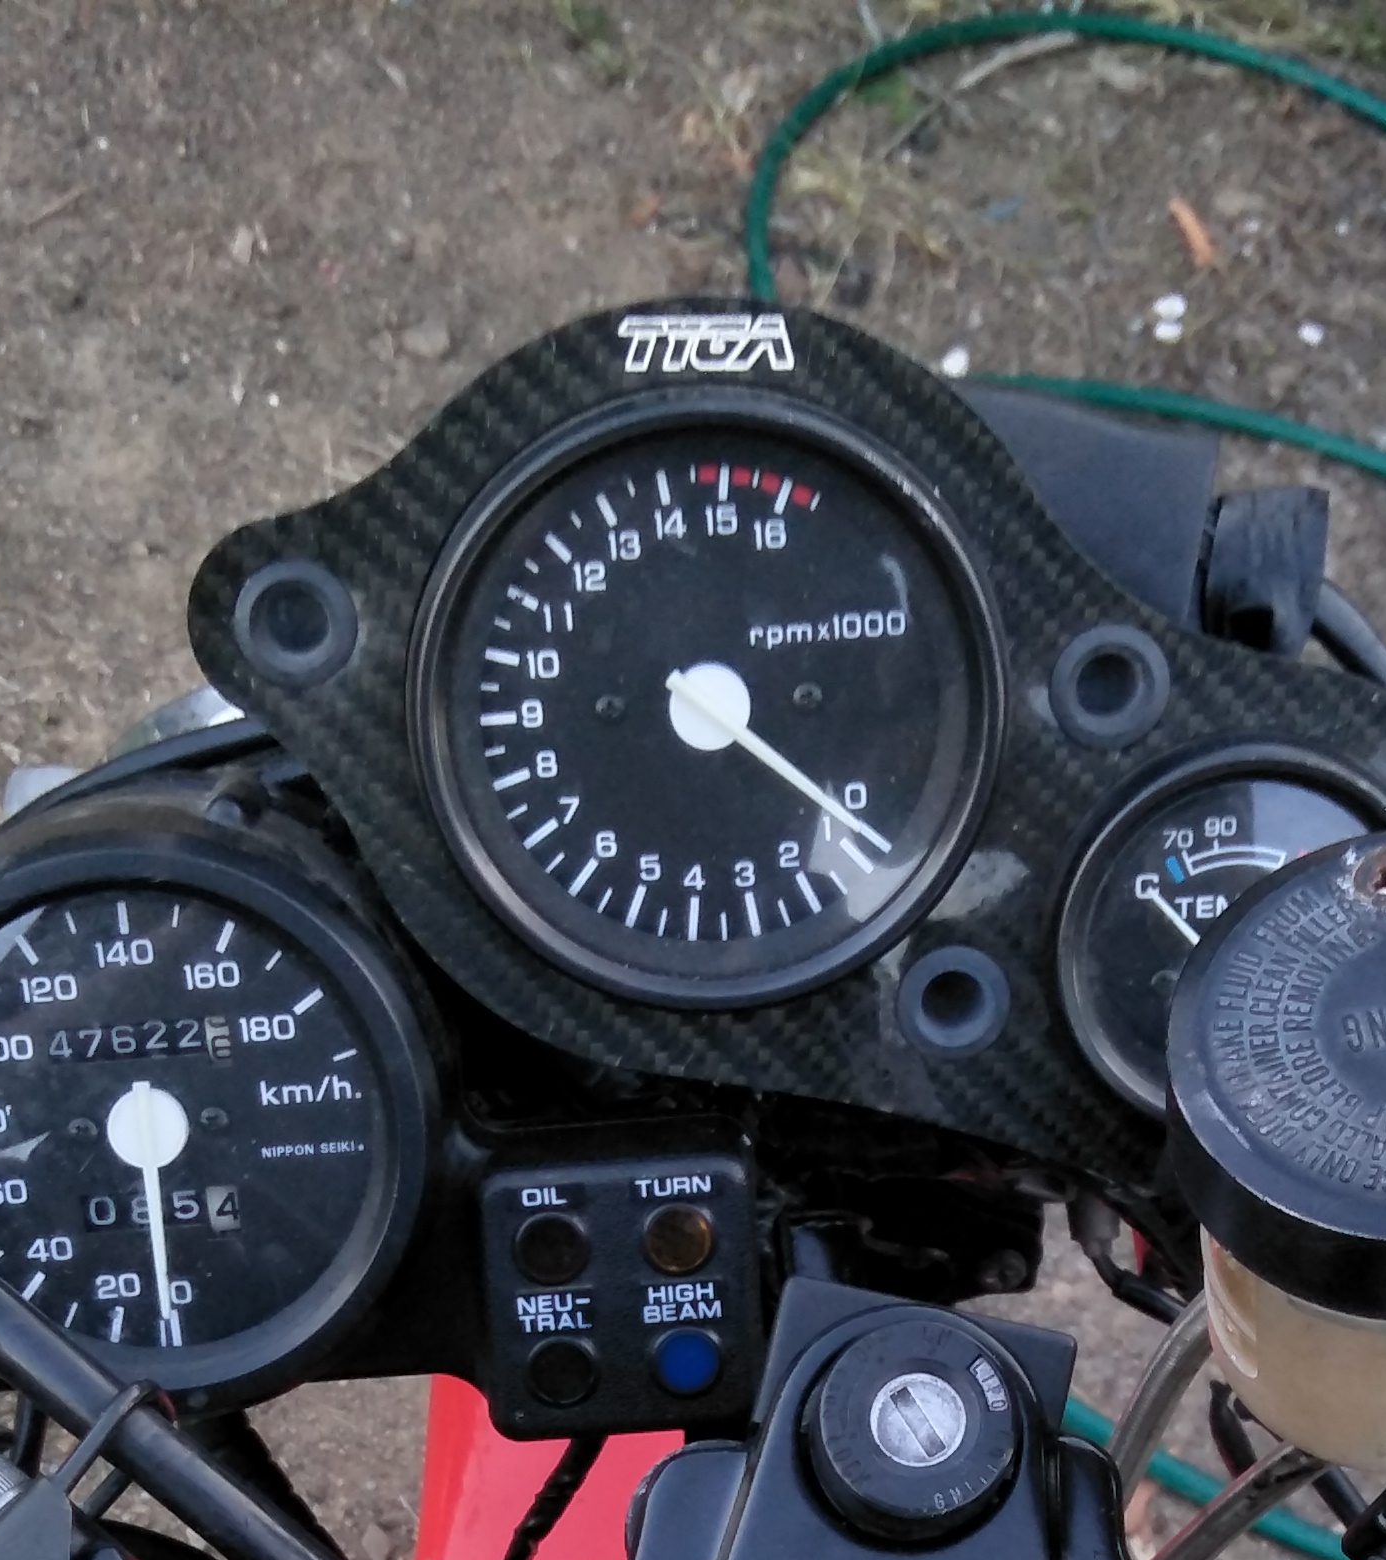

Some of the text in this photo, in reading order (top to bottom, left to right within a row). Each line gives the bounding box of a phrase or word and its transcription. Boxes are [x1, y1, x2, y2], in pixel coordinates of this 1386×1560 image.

[654, 507, 687, 540] 14
[705, 503, 738, 536] 15
[610, 529, 642, 560] 13
[753, 519, 787, 551] 16
[573, 560, 607, 592] 12
[543, 602, 574, 633] 11
[526, 649, 560, 679] 10
[521, 699, 543, 728] 9
[536, 750, 559, 778] 8
[844, 781, 868, 810] 0
[558, 796, 580, 824] 7
[822, 815, 832, 842] 1
[1163, 815, 1237, 850] 70 90
[595, 830, 618, 858] 6
[778, 840, 800, 868] 2
[639, 854, 661, 881] 5
[683, 864, 706, 890] 4
[734, 861, 756, 888] 3
[1135, 873, 1160, 900] C
[1251, 888, 1321, 948] FROM
[94, 939, 154, 968] 140
[19, 973, 77, 1003] 120
[183, 960, 240, 990] 160
[1216, 950, 1263, 1012] FLUID
[238, 1014, 296, 1043] 180
[1285, 1037, 1363, 1120] BEFORE
[261, 1143, 315, 1159] NIPPON
[1291, 1141, 1362, 1184] ONLY
[521, 1187, 567, 1207] OIL
[636, 1175, 712, 1199] TURN
[26, 1235, 73, 1261] 40
[94, 1273, 142, 1299] 20
[169, 1281, 193, 1304] 0
[647, 1283, 715, 1305] HIGH
[517, 1294, 592, 1316] NEU-
[643, 1300, 723, 1325] BEAM
[520, 1311, 593, 1333] TRAL
